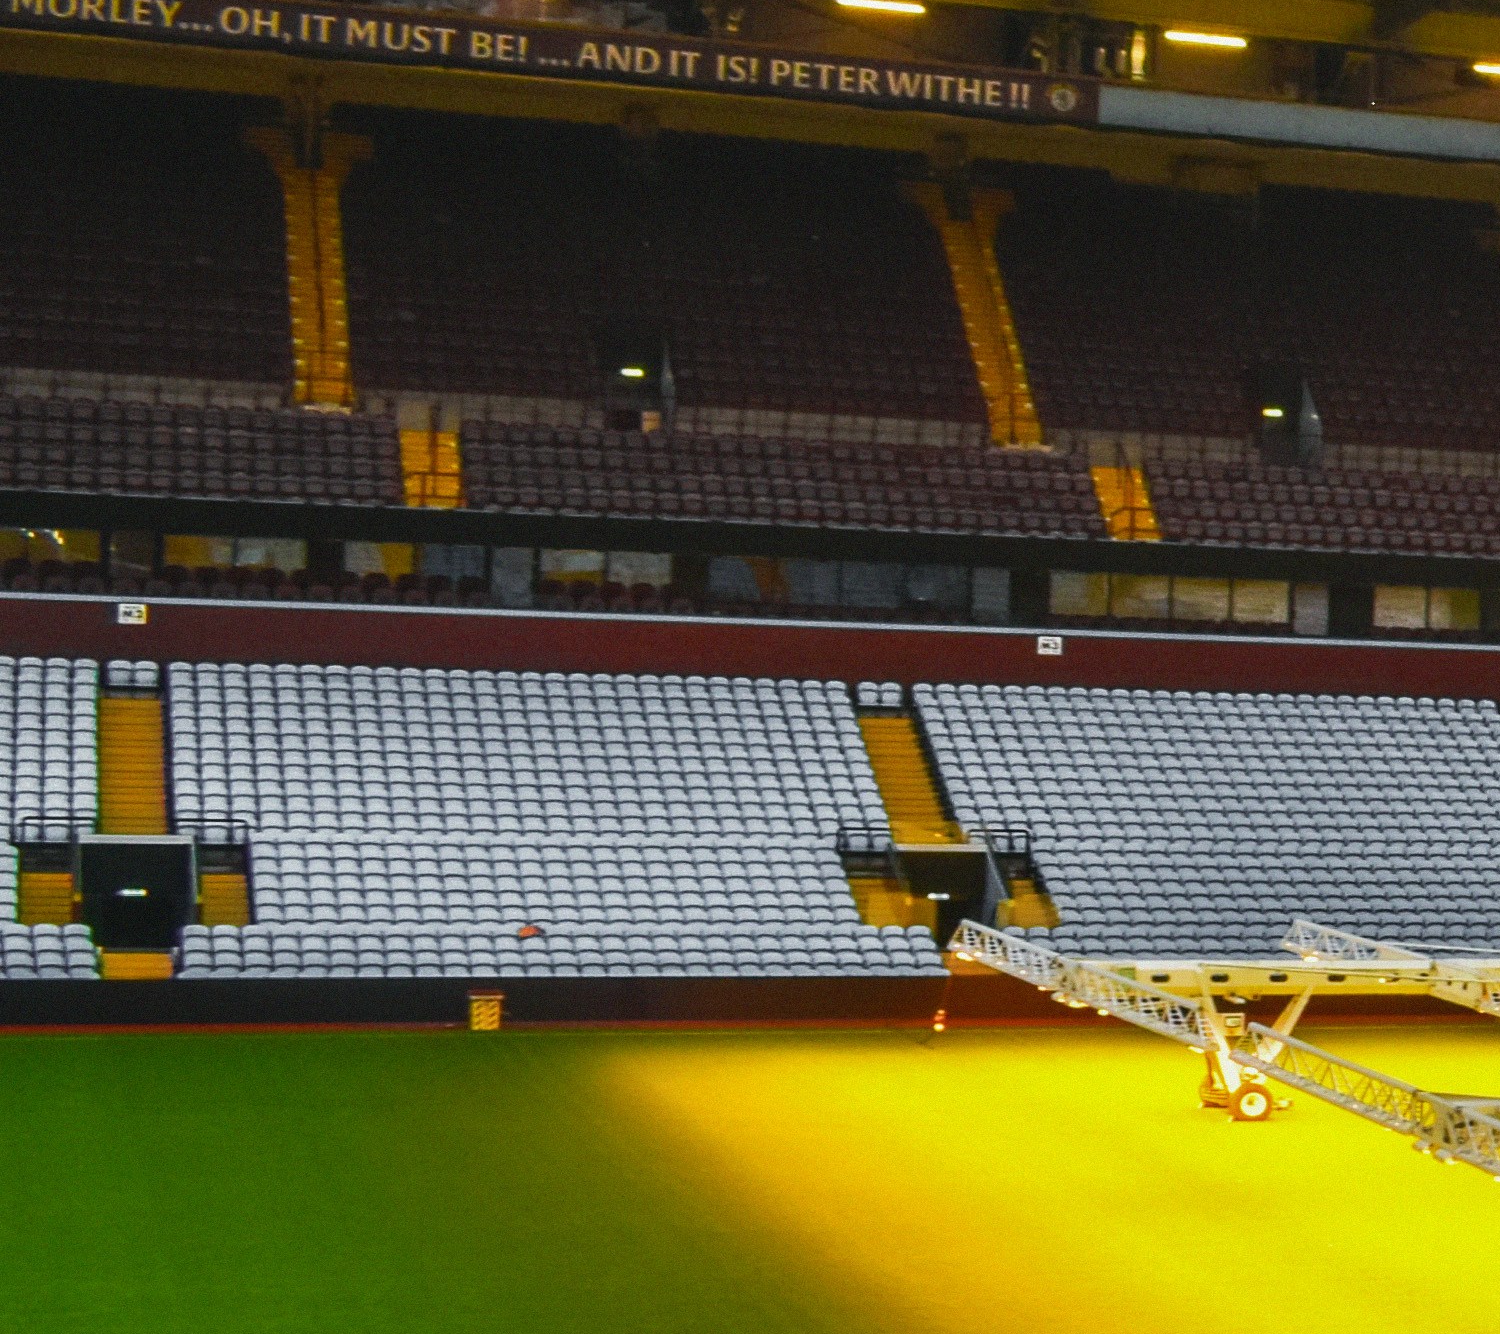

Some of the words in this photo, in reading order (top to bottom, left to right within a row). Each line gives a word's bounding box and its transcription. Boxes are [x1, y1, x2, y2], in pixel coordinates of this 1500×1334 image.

[218, 6, 292, 44] OH,
[299, 13, 338, 44] IT
[345, 20, 457, 57] MUST
[469, 31, 530, 65] BE!
[667, 50, 700, 79] IT
[716, 54, 759, 84] IS!
[769, 59, 881, 96] PETER
[887, 70, 1003, 108] WITHE
